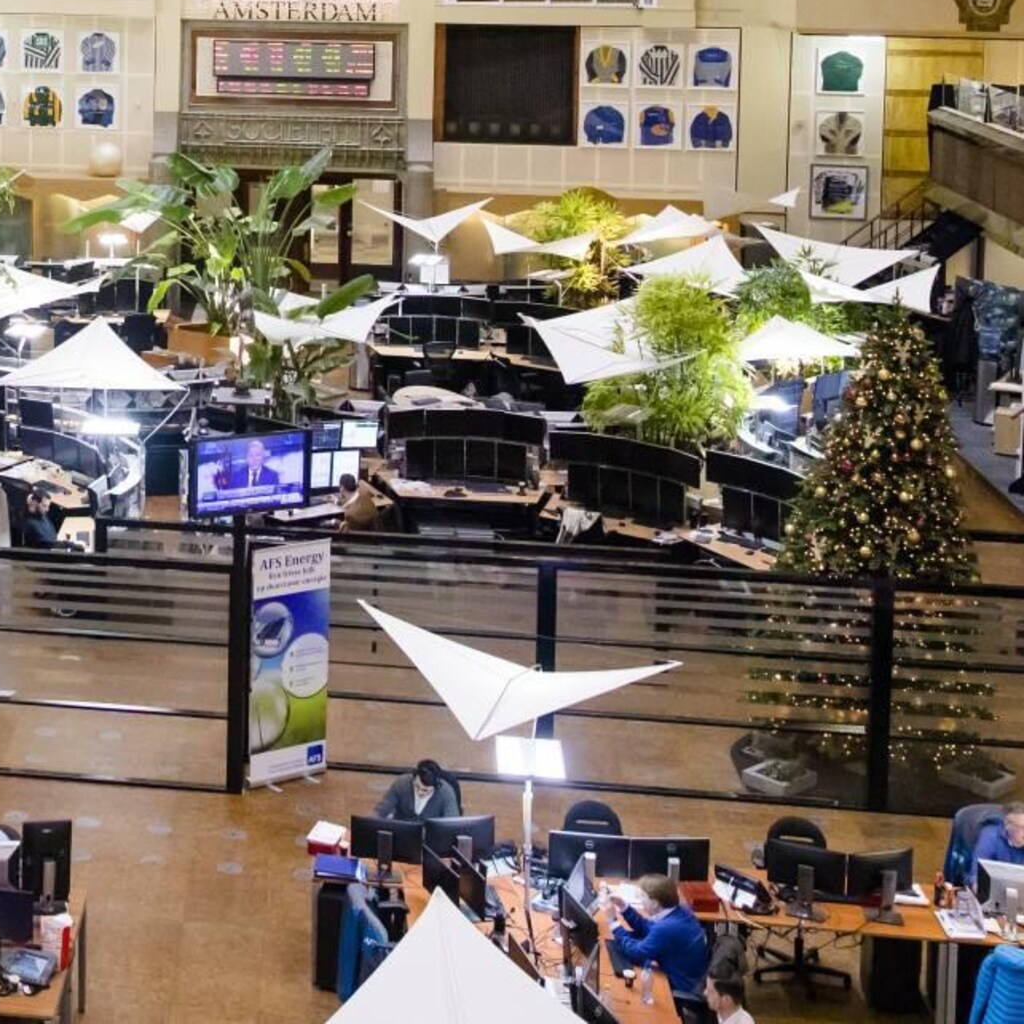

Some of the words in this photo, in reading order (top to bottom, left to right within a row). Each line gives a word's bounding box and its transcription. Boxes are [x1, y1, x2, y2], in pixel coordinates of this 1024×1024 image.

[213, 1, 377, 22] AMSTERDAM
[260, 556, 282, 571] AFS
[285, 552, 325, 567] Energy
